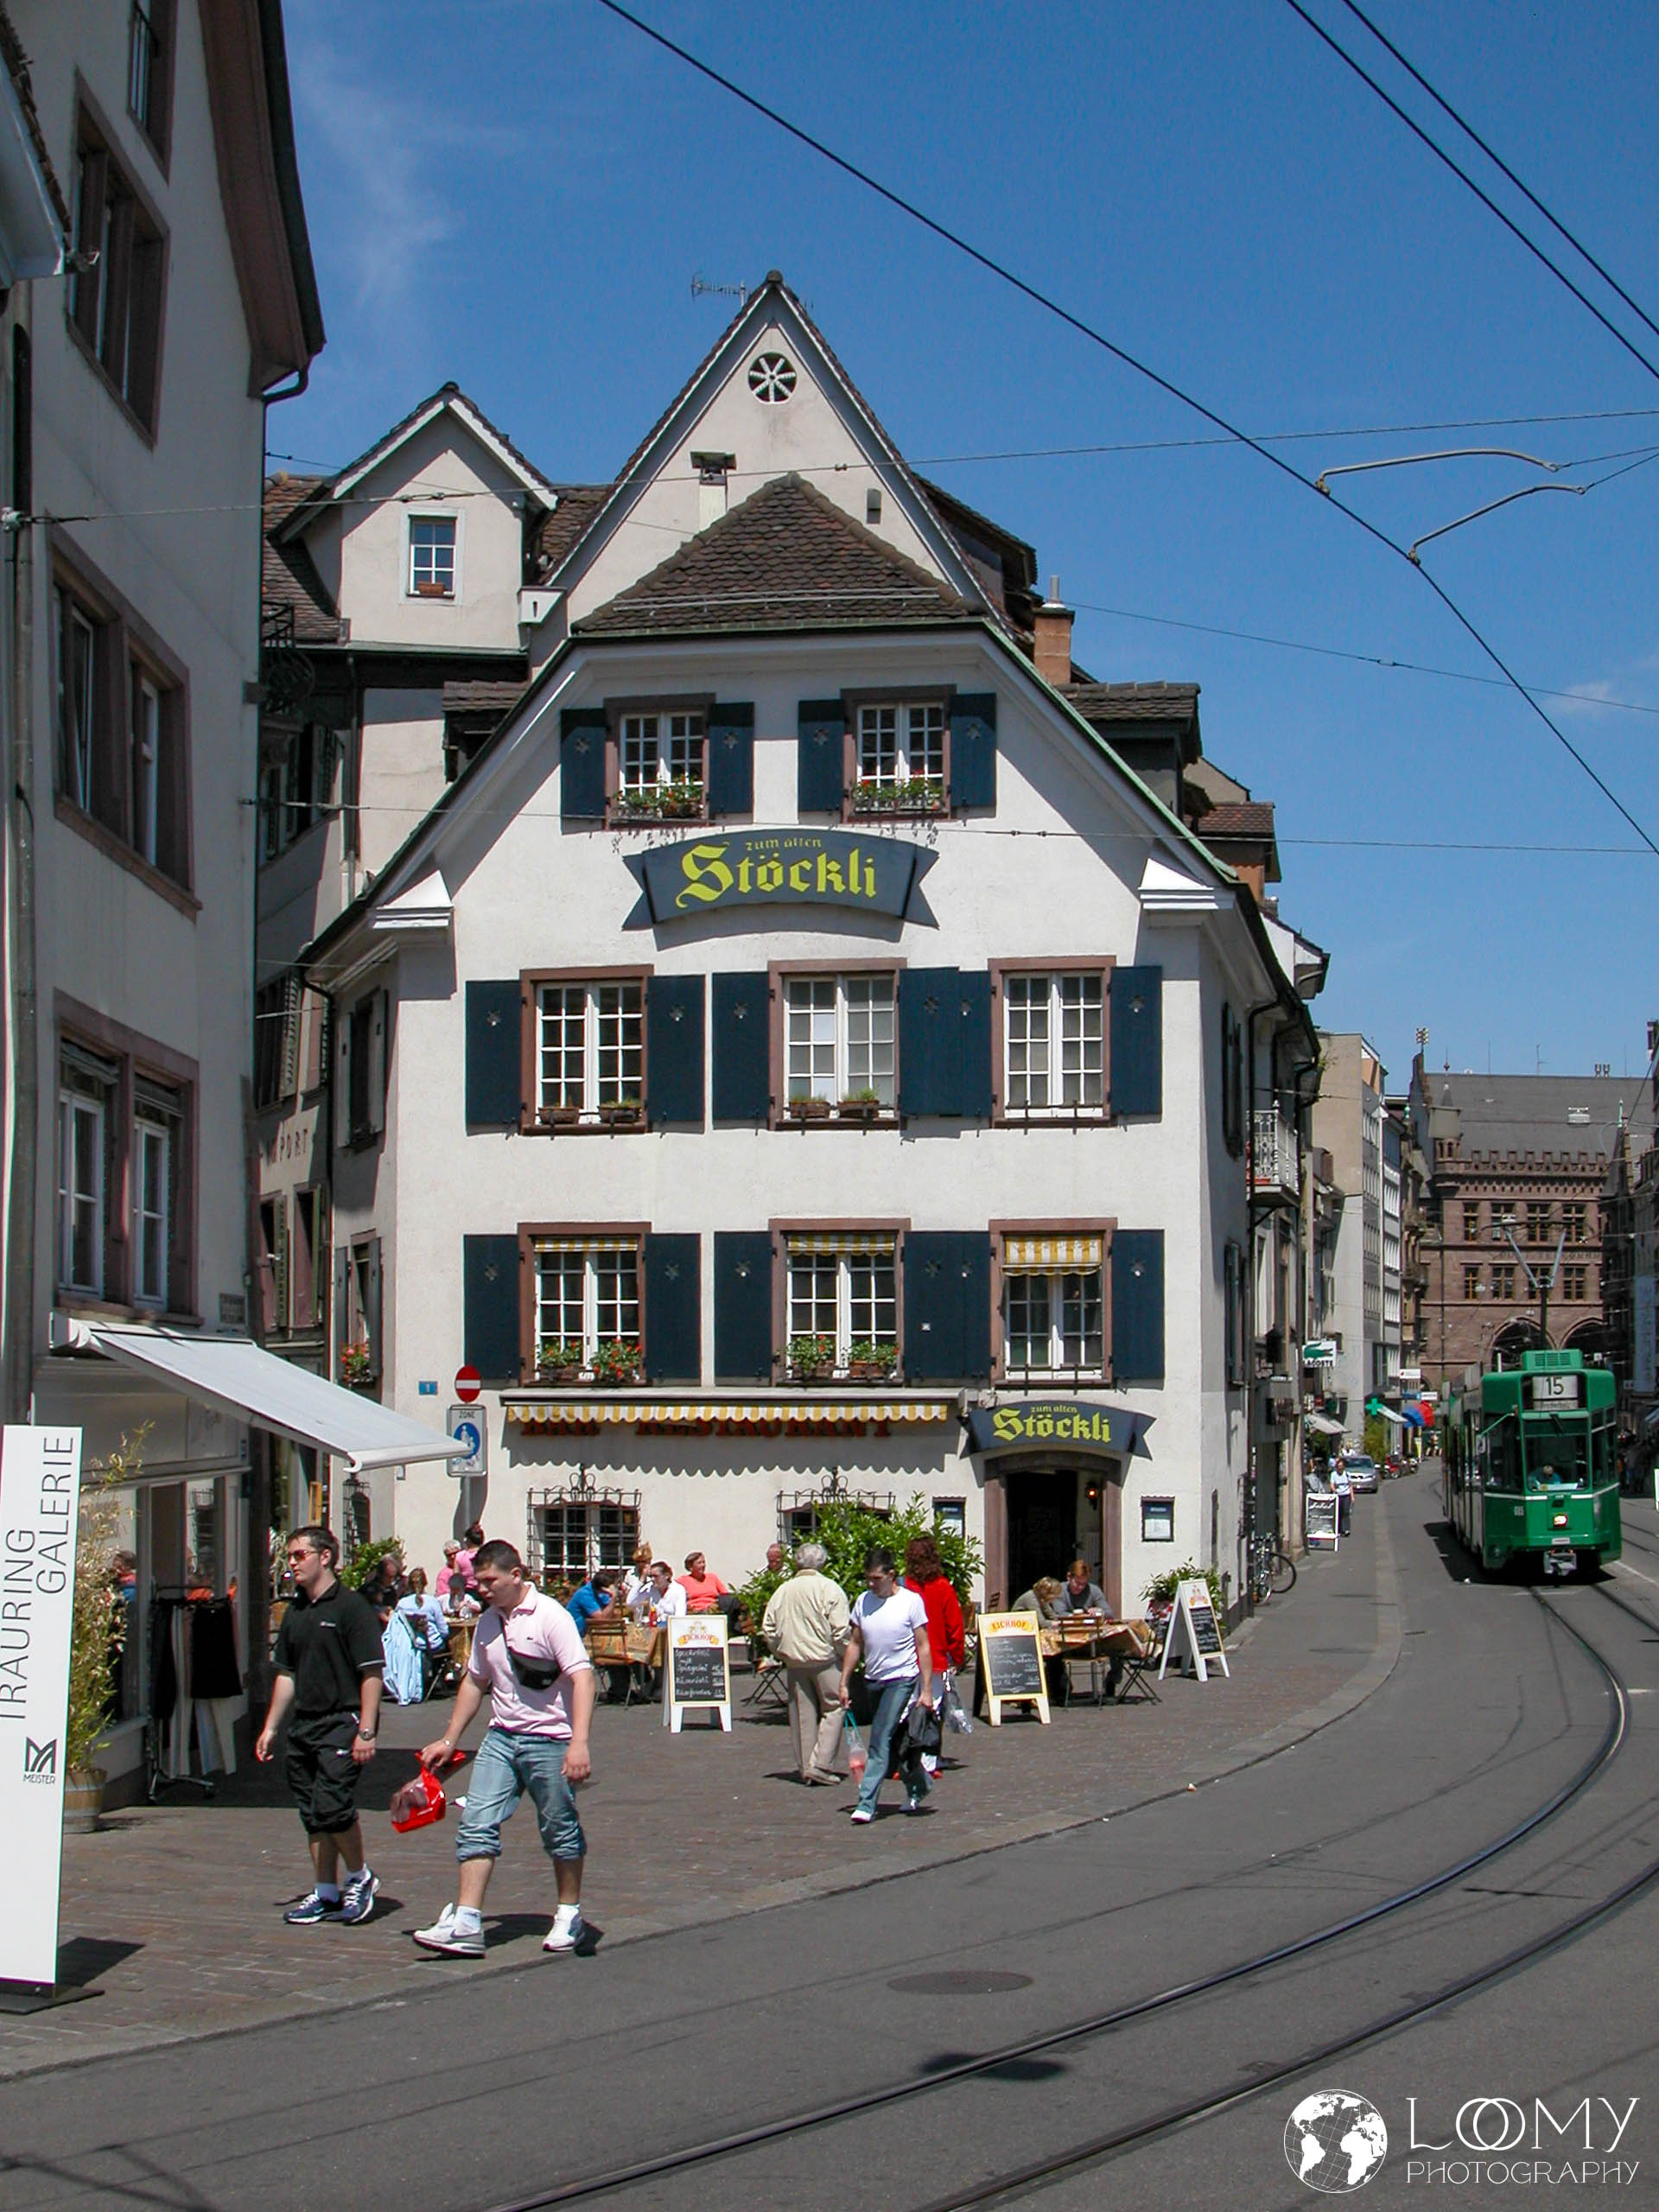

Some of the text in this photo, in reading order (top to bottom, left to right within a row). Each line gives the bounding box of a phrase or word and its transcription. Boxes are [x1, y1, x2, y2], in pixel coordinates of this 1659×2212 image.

[746, 838, 779, 851] zum
[675, 842, 876, 908] Stöckli
[1546, 1376, 1564, 1395] 15
[993, 1408, 1111, 1443] Stöckli
[35, 1436, 74, 1594] GALERIE
[22, 1774, 56, 1785] MEISTER
